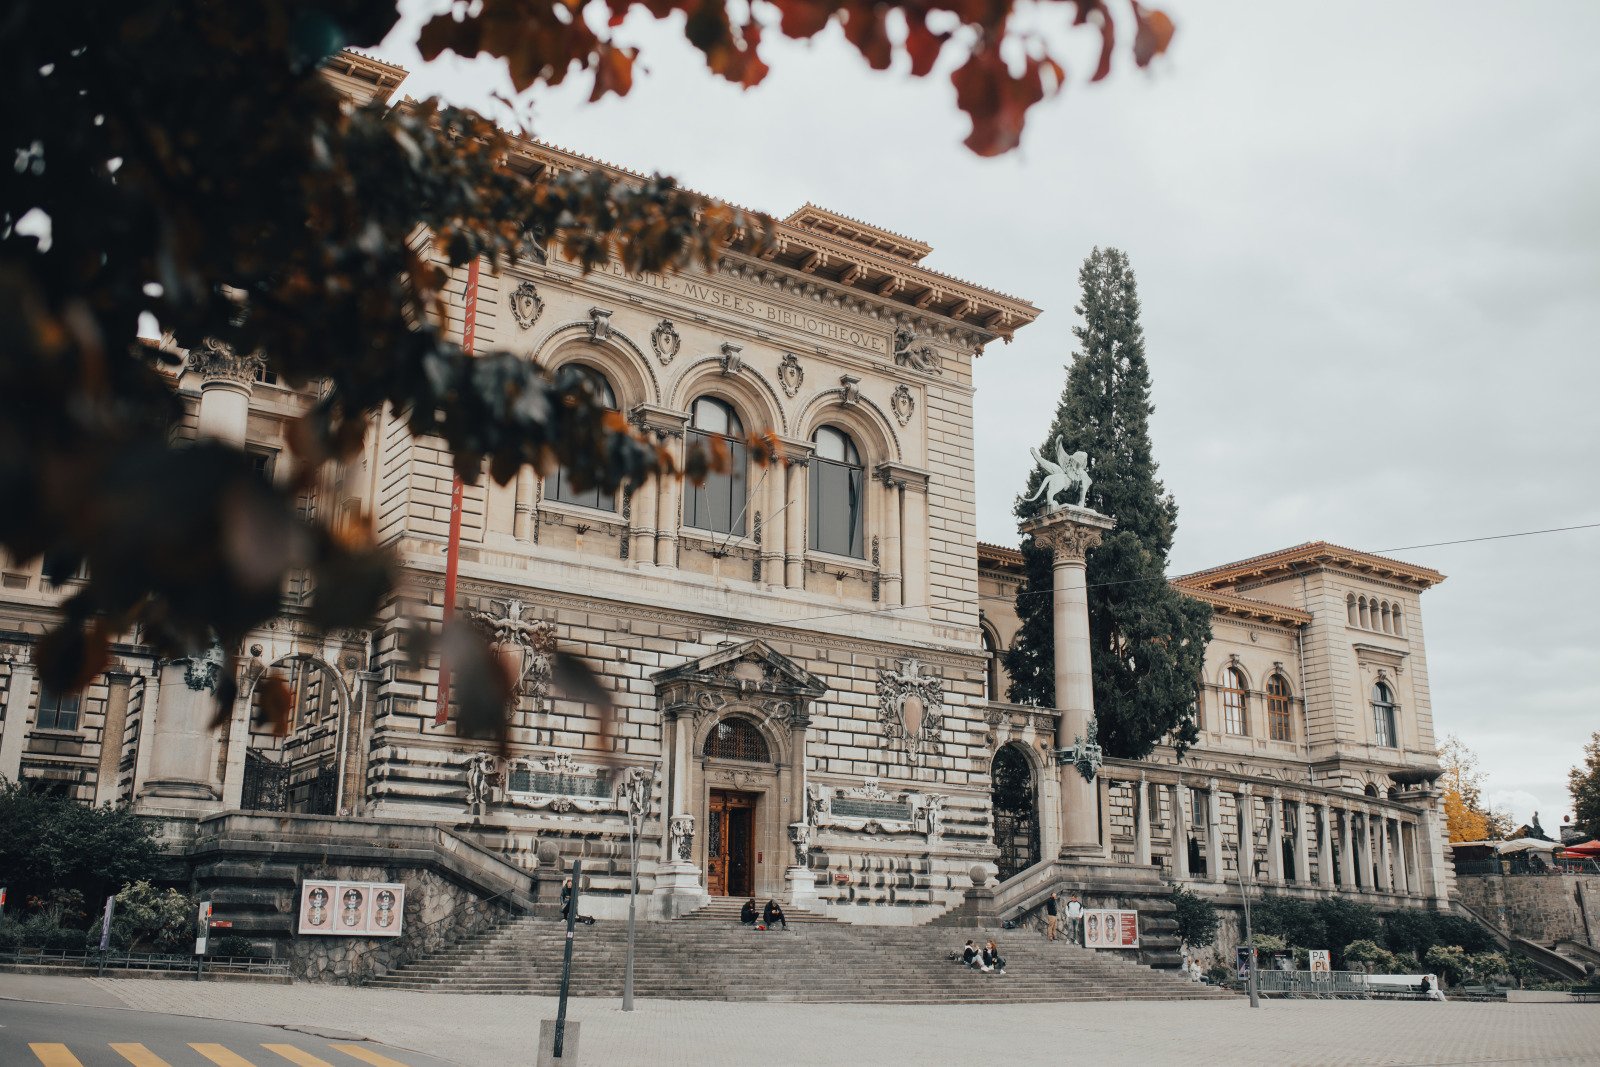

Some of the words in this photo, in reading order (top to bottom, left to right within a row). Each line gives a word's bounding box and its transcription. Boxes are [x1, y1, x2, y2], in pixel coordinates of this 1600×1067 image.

[683, 282, 755, 314] MVSEES
[767, 306, 881, 350] BIBLIOTHEQVE
[1312, 951, 1325, 960] PA
